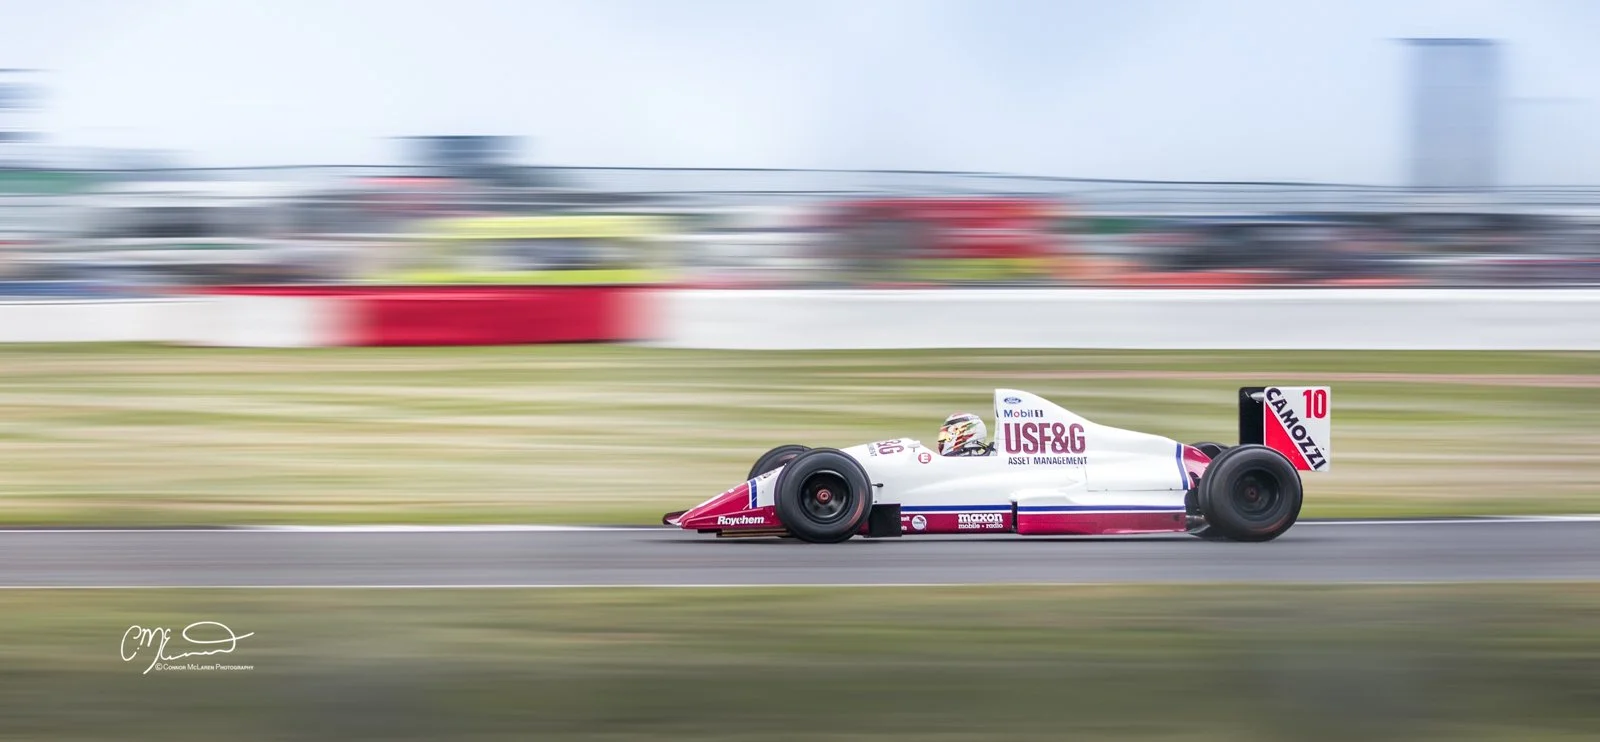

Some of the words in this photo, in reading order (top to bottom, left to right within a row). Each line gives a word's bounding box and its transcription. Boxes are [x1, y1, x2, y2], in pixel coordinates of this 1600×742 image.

[1303, 390, 1327, 418] 10
[1004, 409, 1033, 418] Mobil
[1266, 387, 1327, 470] CAMOZZI
[1004, 422, 1086, 454] USF&G
[1008, 457, 1030, 465] ASSET
[1033, 456, 1087, 465] MANAGEMENT
[717, 515, 764, 526] Raychem
[958, 513, 1003, 523] maxon
